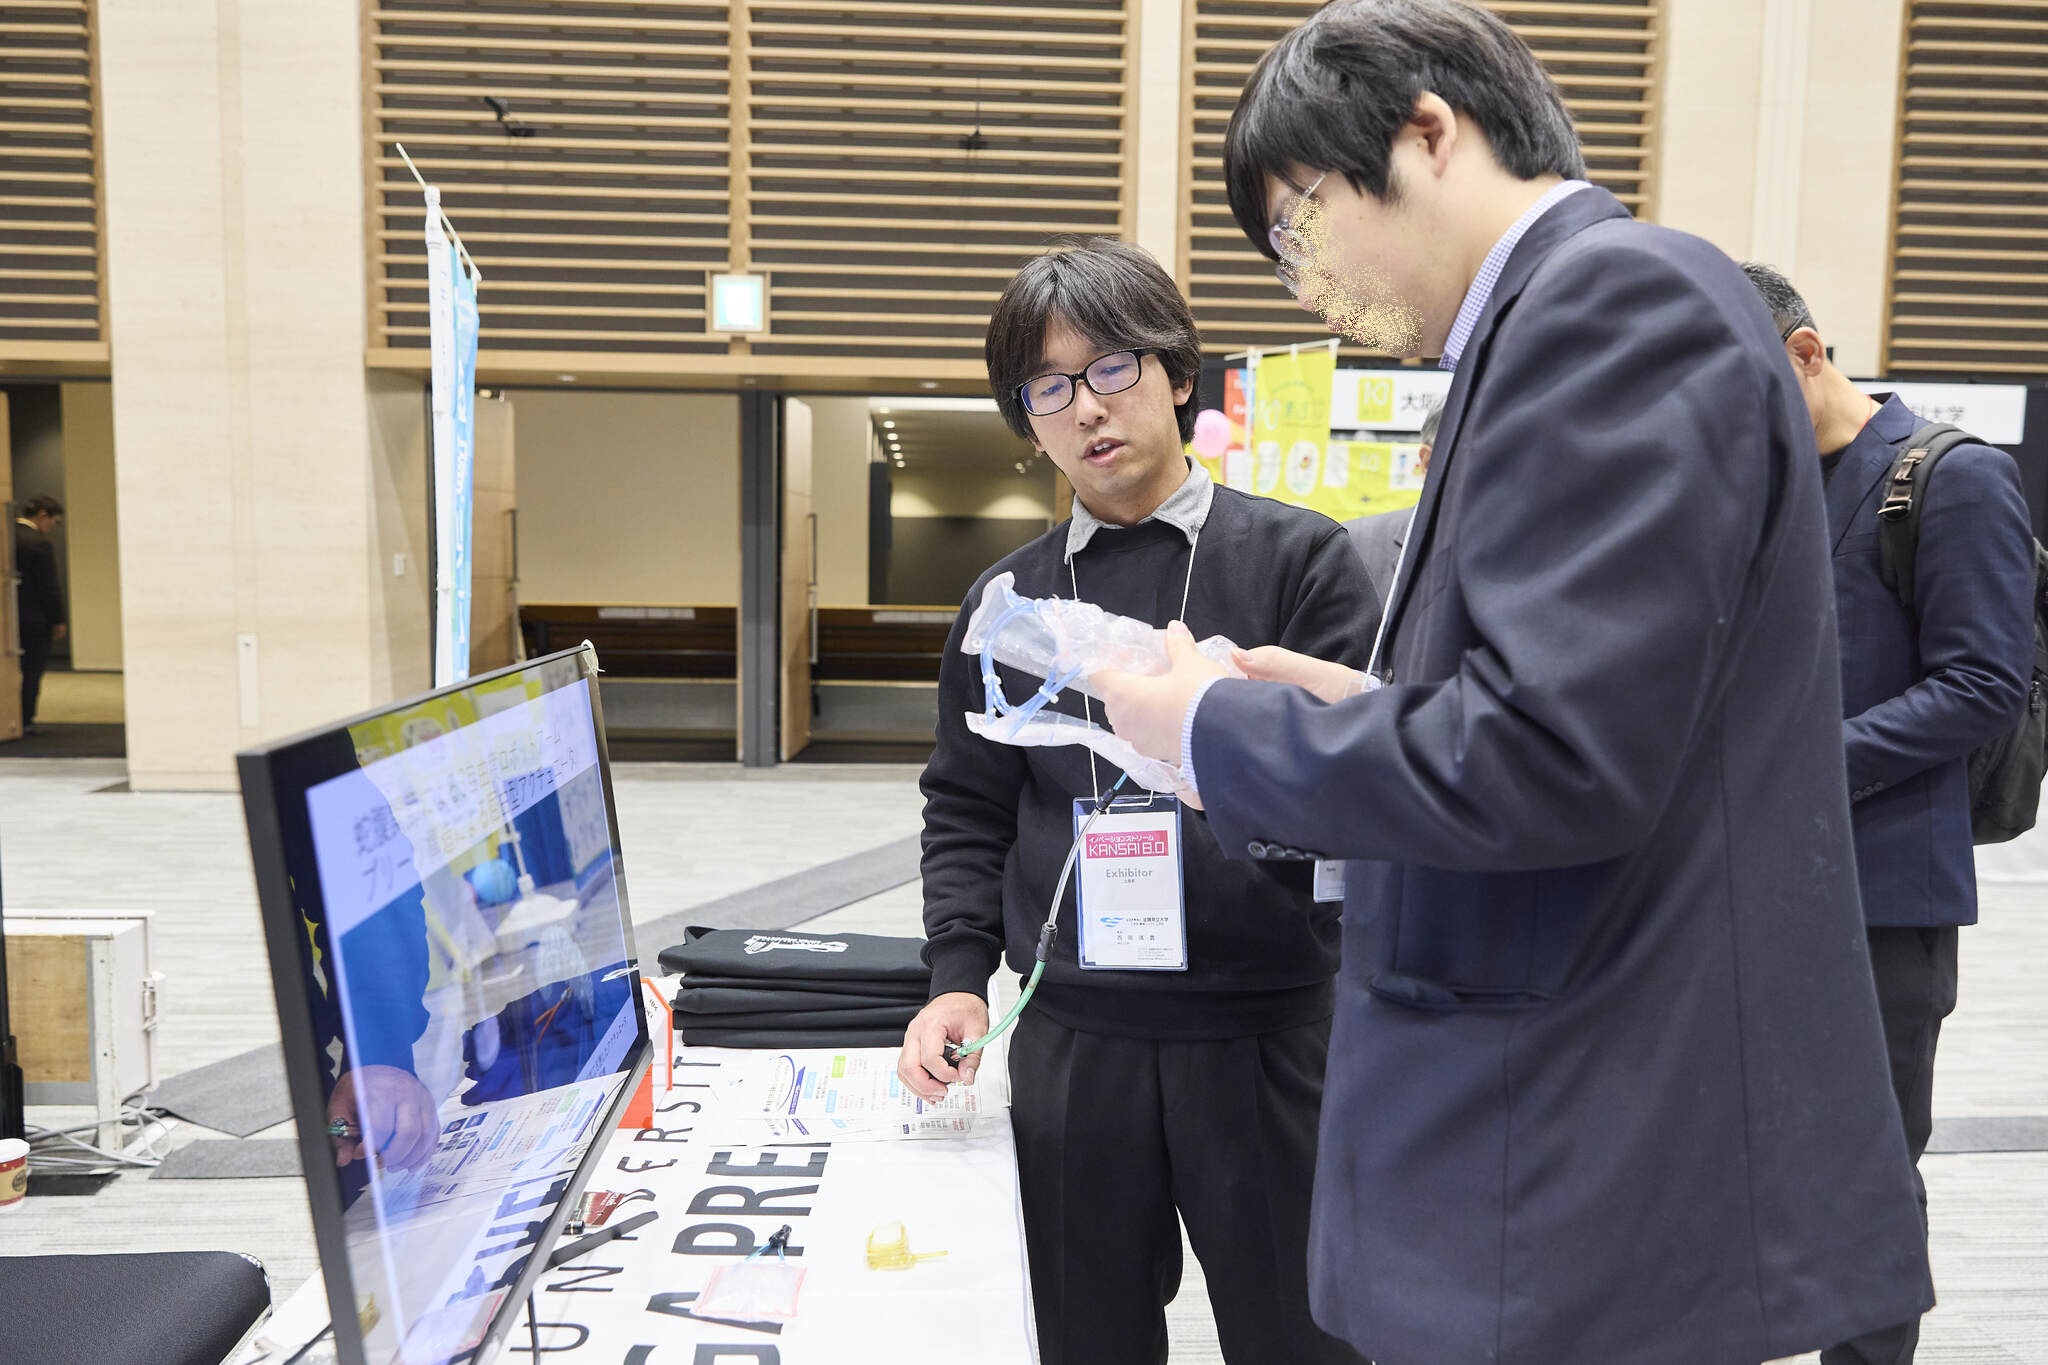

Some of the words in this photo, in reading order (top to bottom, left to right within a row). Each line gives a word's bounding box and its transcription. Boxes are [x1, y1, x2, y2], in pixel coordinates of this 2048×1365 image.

[1089, 842, 1141, 857] KANSAI
[1143, 841, 1165, 855] 8.0
[1105, 868, 1154, 879] Exhibitor
